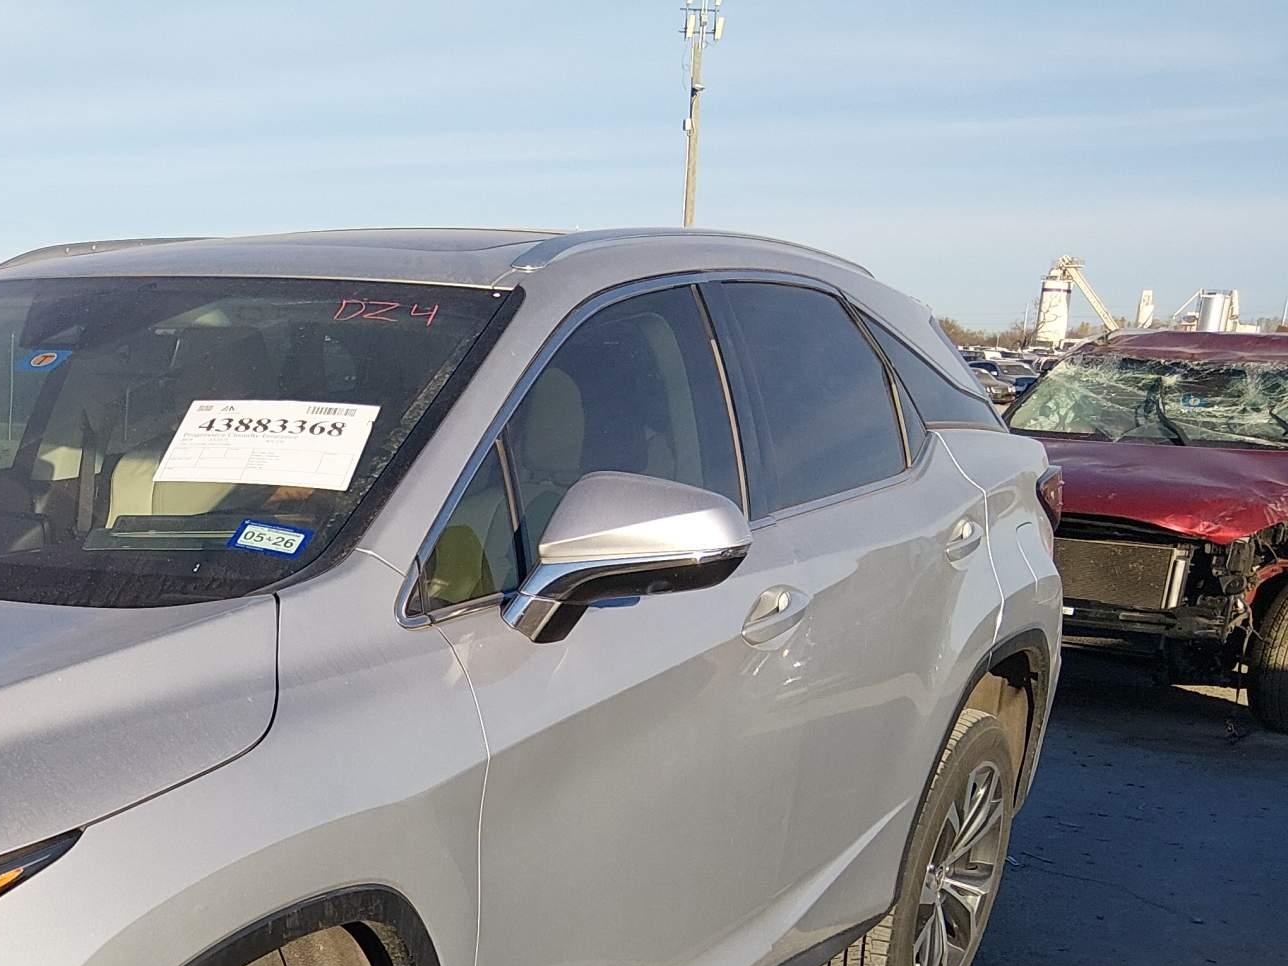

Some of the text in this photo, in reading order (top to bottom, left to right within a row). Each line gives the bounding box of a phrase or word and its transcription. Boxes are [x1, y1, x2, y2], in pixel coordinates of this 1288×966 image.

[334, 299, 439, 326] DZ 4
[198, 418, 347, 437] 43883368
